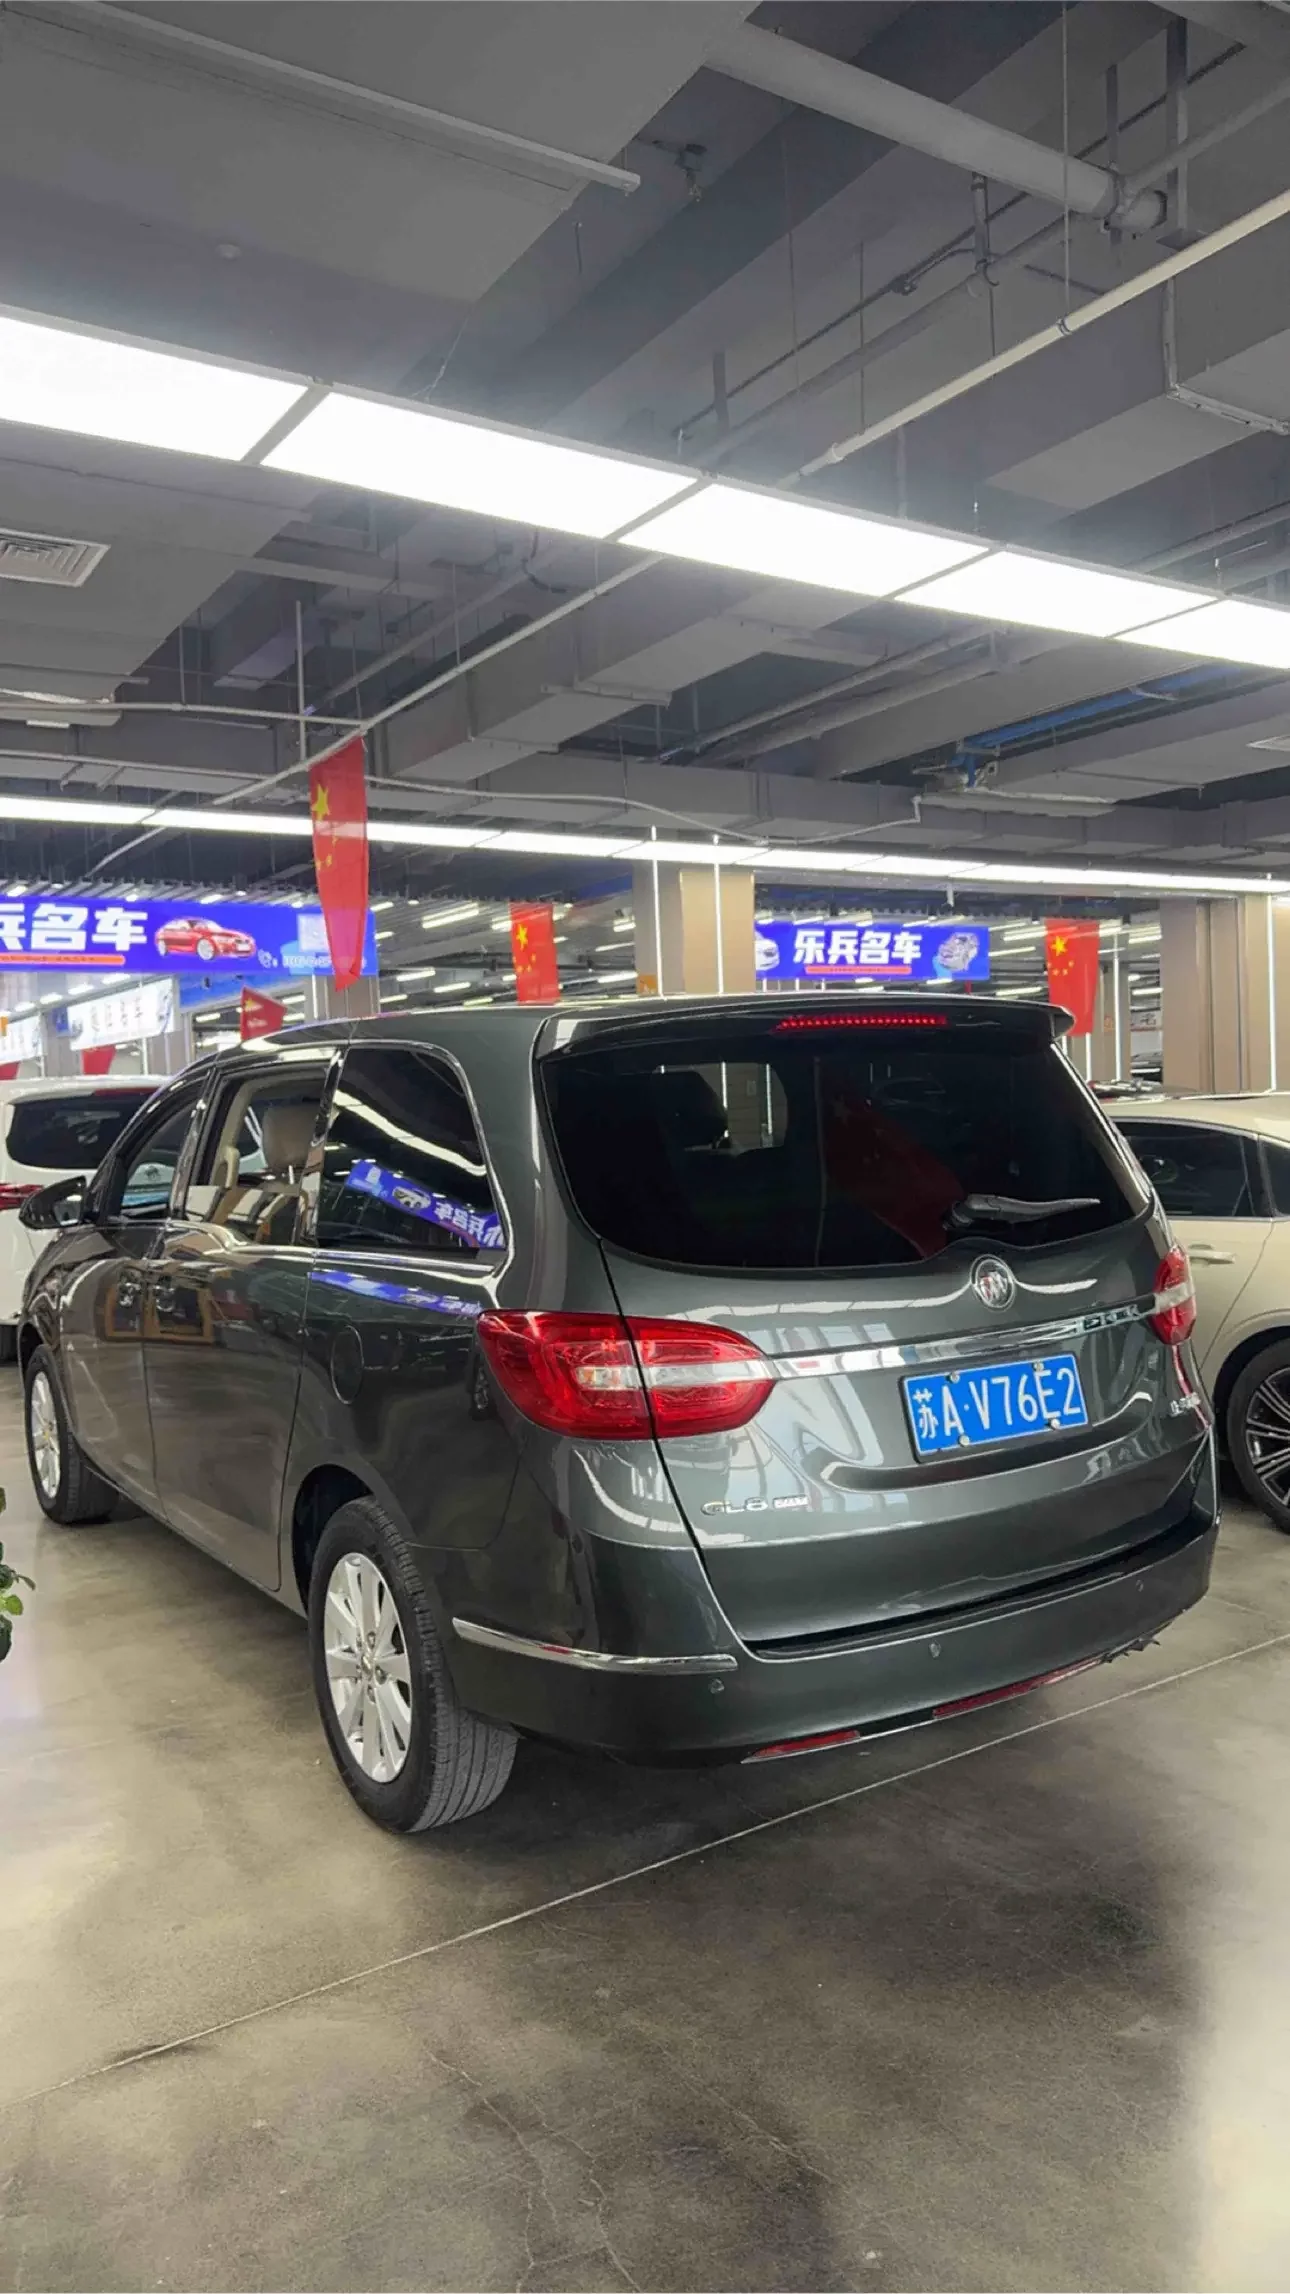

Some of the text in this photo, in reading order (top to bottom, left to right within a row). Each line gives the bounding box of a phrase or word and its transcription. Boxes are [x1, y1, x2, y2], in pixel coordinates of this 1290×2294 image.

[793, 930, 922, 964] 乐兵名车
[700, 1498, 769, 1515] GL8
